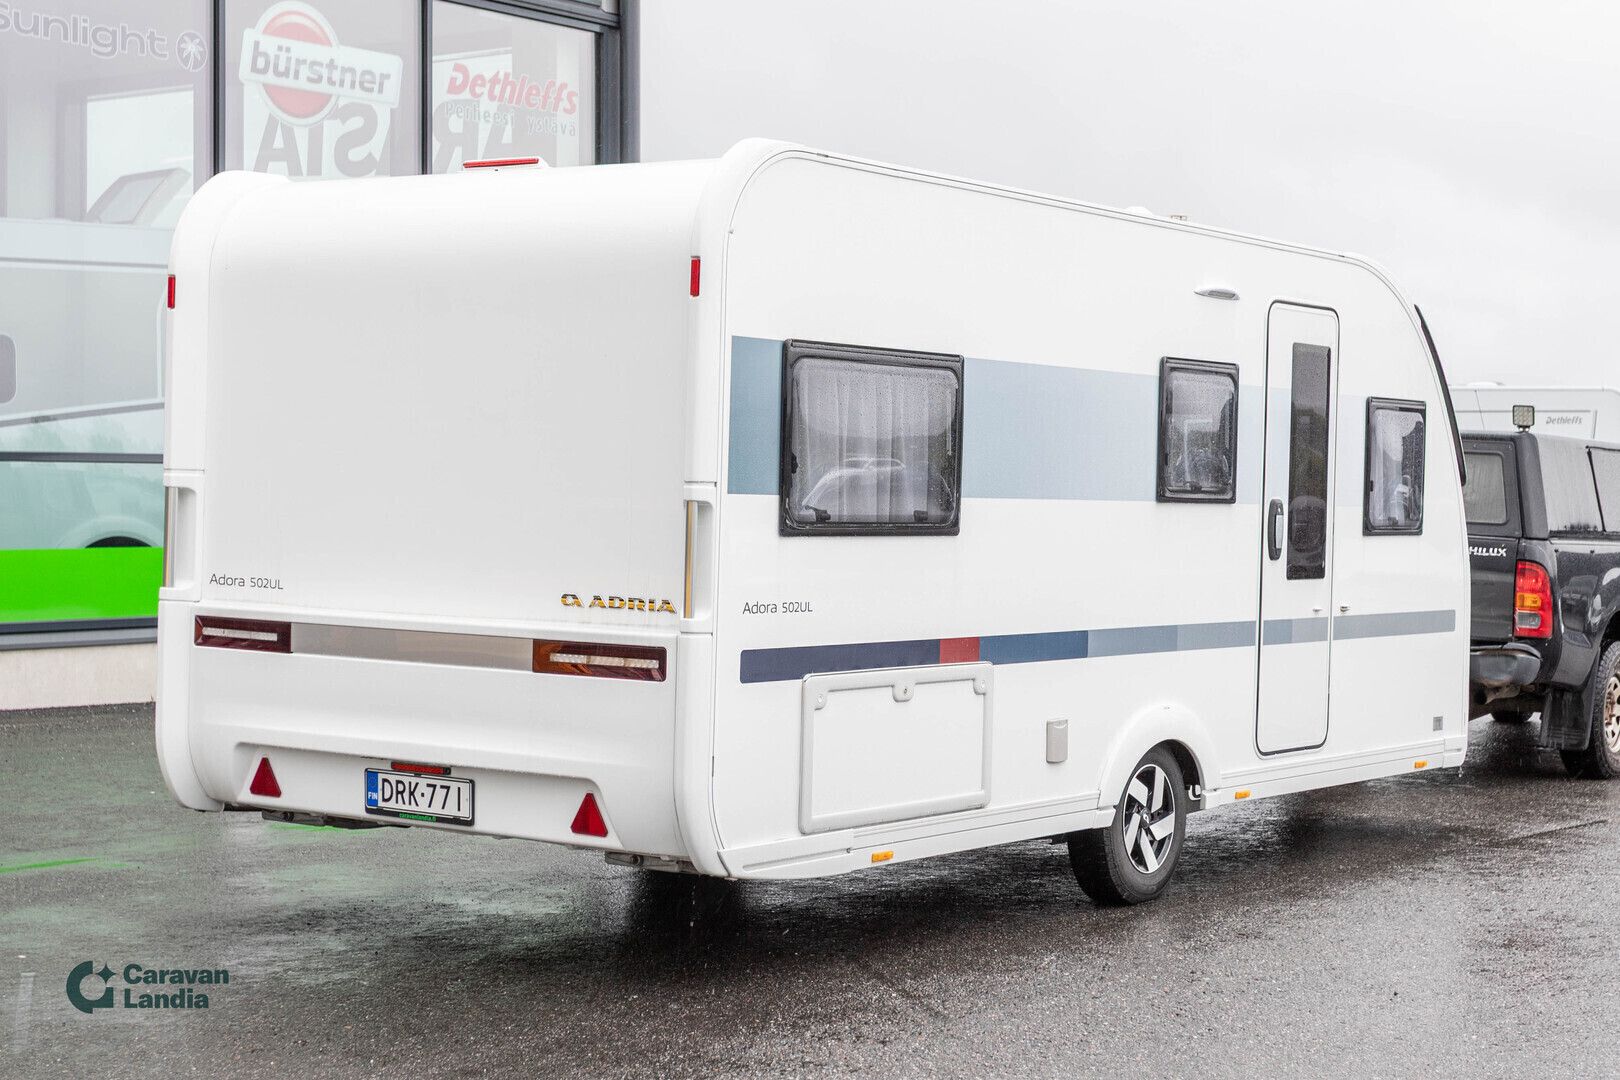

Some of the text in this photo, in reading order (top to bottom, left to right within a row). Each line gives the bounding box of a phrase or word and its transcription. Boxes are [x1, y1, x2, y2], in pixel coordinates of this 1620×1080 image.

[250, 39, 392, 95] bürstner
[446, 62, 579, 116] Dethleffs
[1468, 545, 1507, 557] HILUX
[209, 573, 284, 590] Adora 502UL
[588, 595, 677, 614] ADRIA
[742, 600, 814, 615] Adora 502UL
[367, 777, 462, 812] FIN DRK-771
